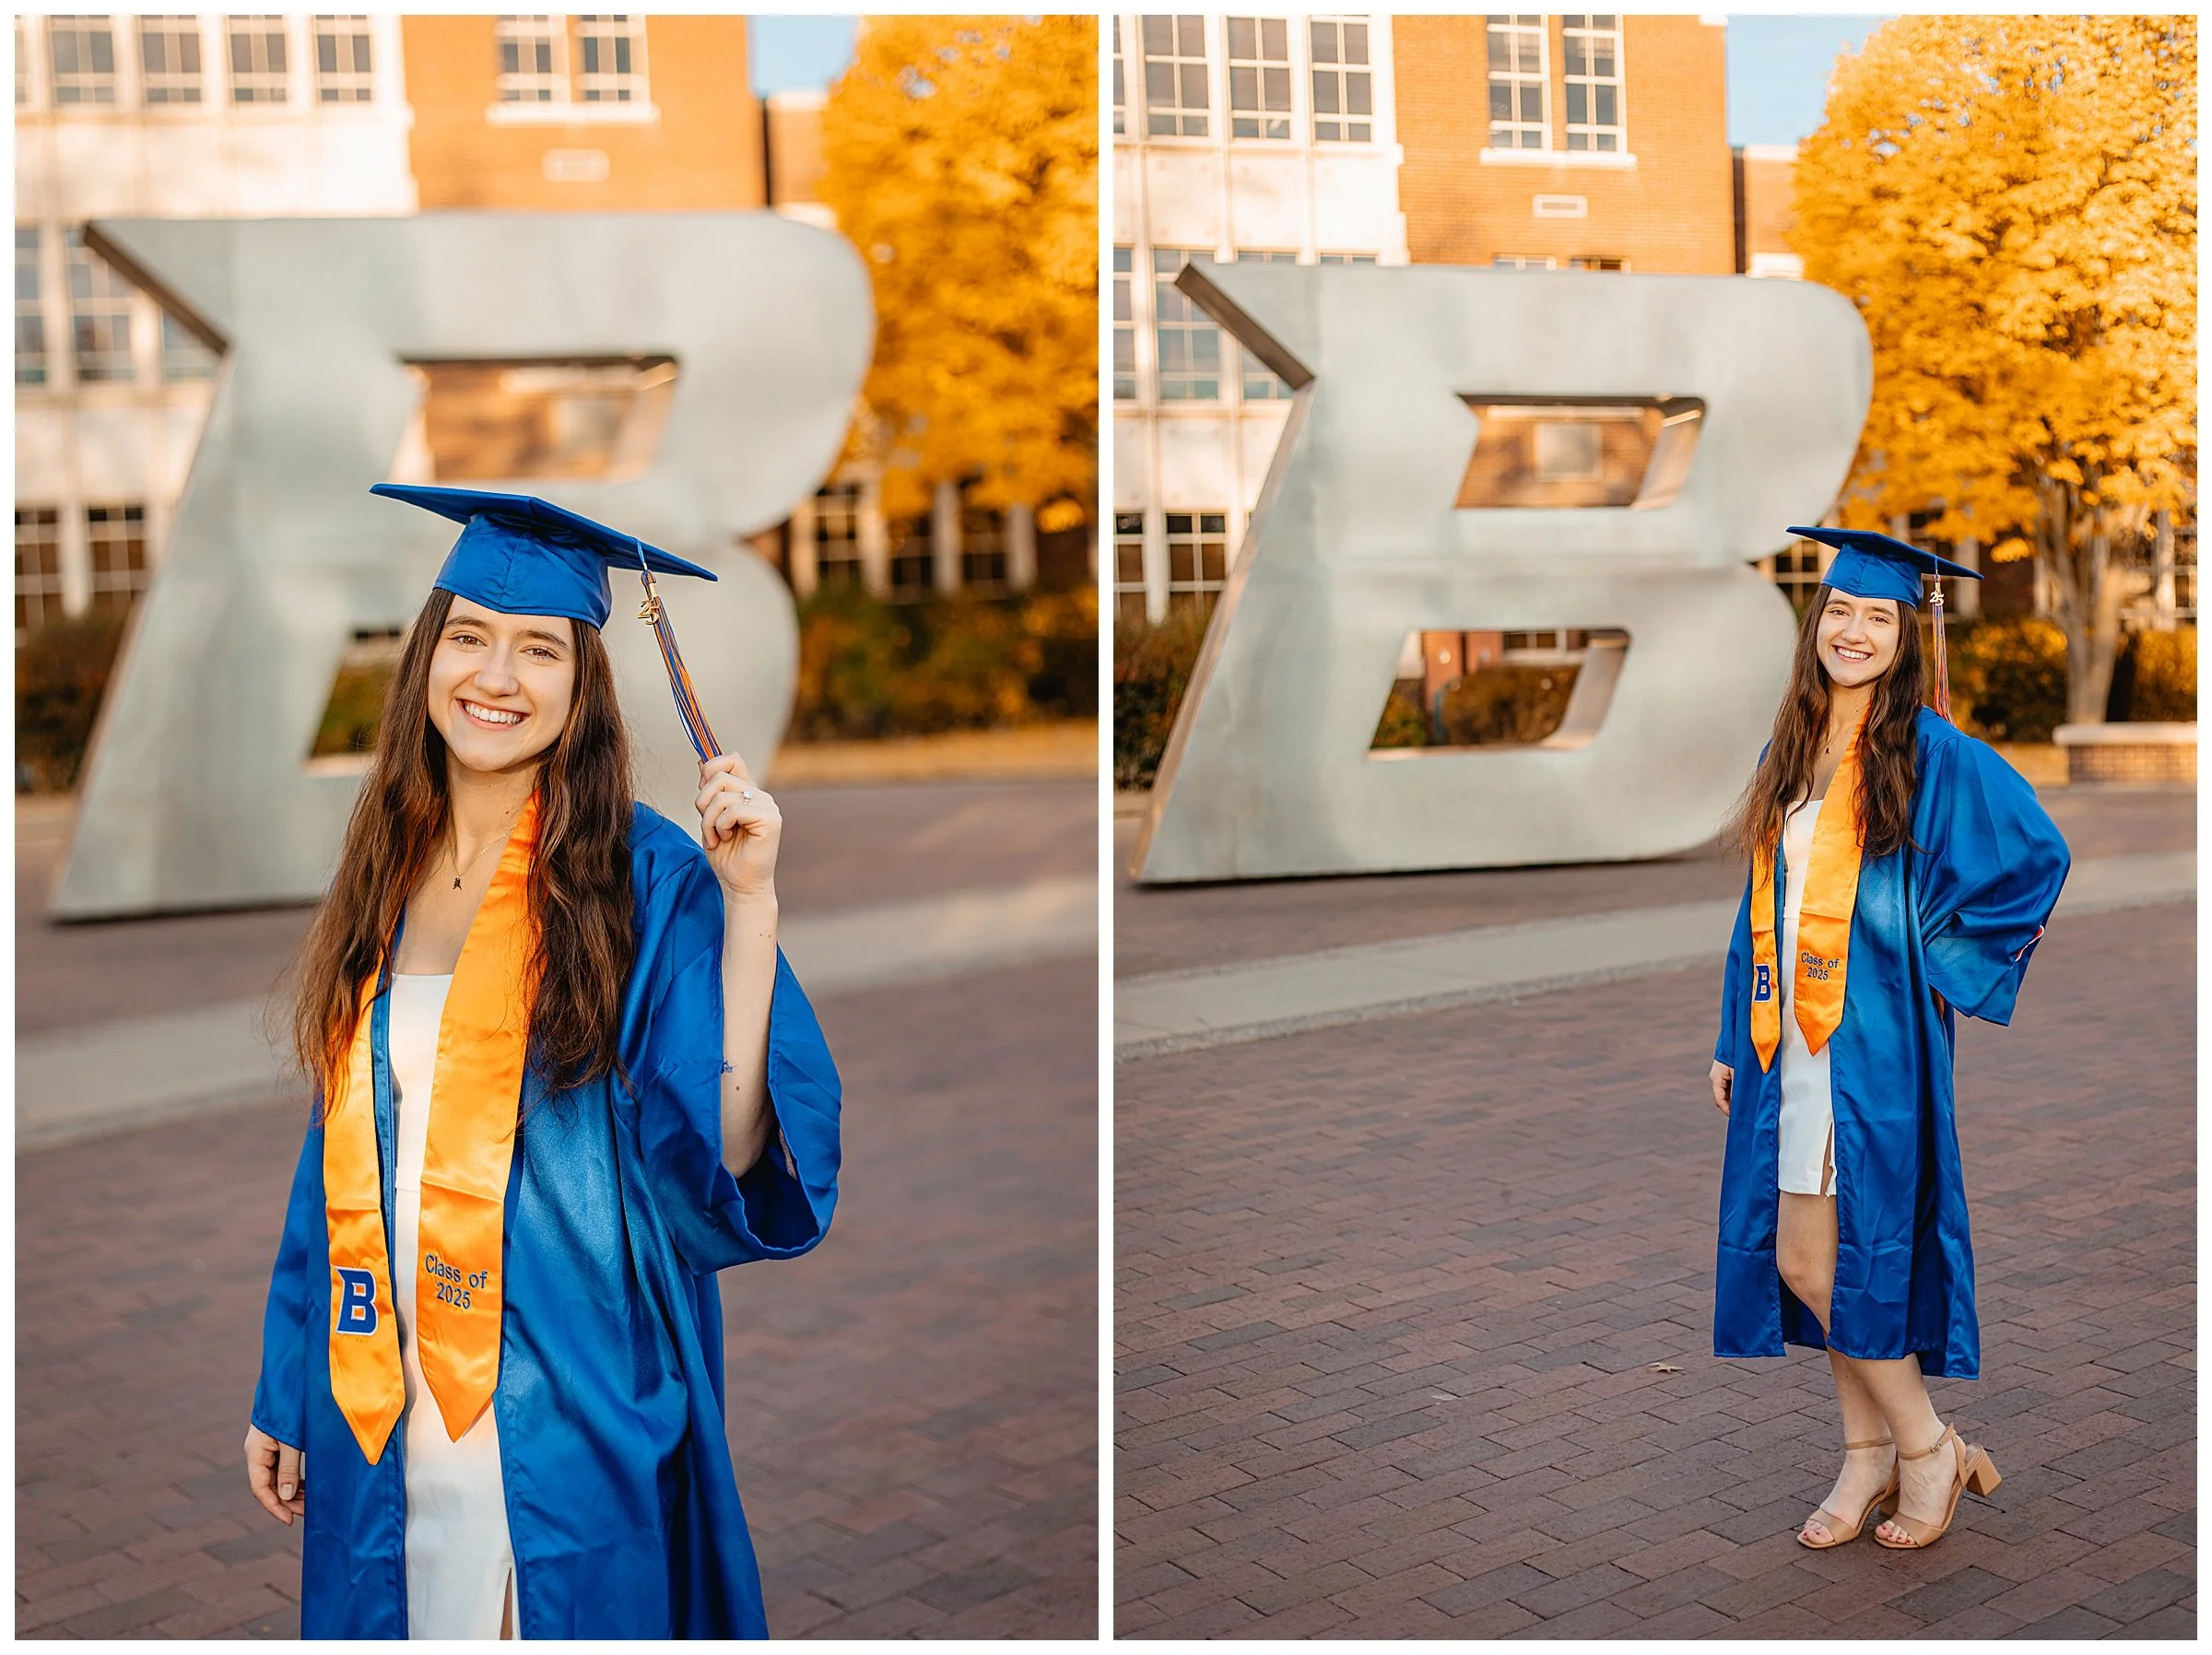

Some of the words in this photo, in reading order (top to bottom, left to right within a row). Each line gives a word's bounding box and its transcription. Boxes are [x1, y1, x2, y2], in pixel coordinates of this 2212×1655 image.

[52, 212, 876, 920] B
[1132, 262, 1874, 885] B
[1929, 591, 1945, 606] 25
[1801, 952, 1824, 967] Class
[1828, 958, 1840, 969] of
[1806, 967, 1829, 981] 2025
[1753, 963, 1772, 1003] B
[425, 1253, 462, 1284] Class
[468, 1270, 488, 1289] of
[335, 1265, 379, 1336] B
[436, 1282, 471, 1309] 2025
